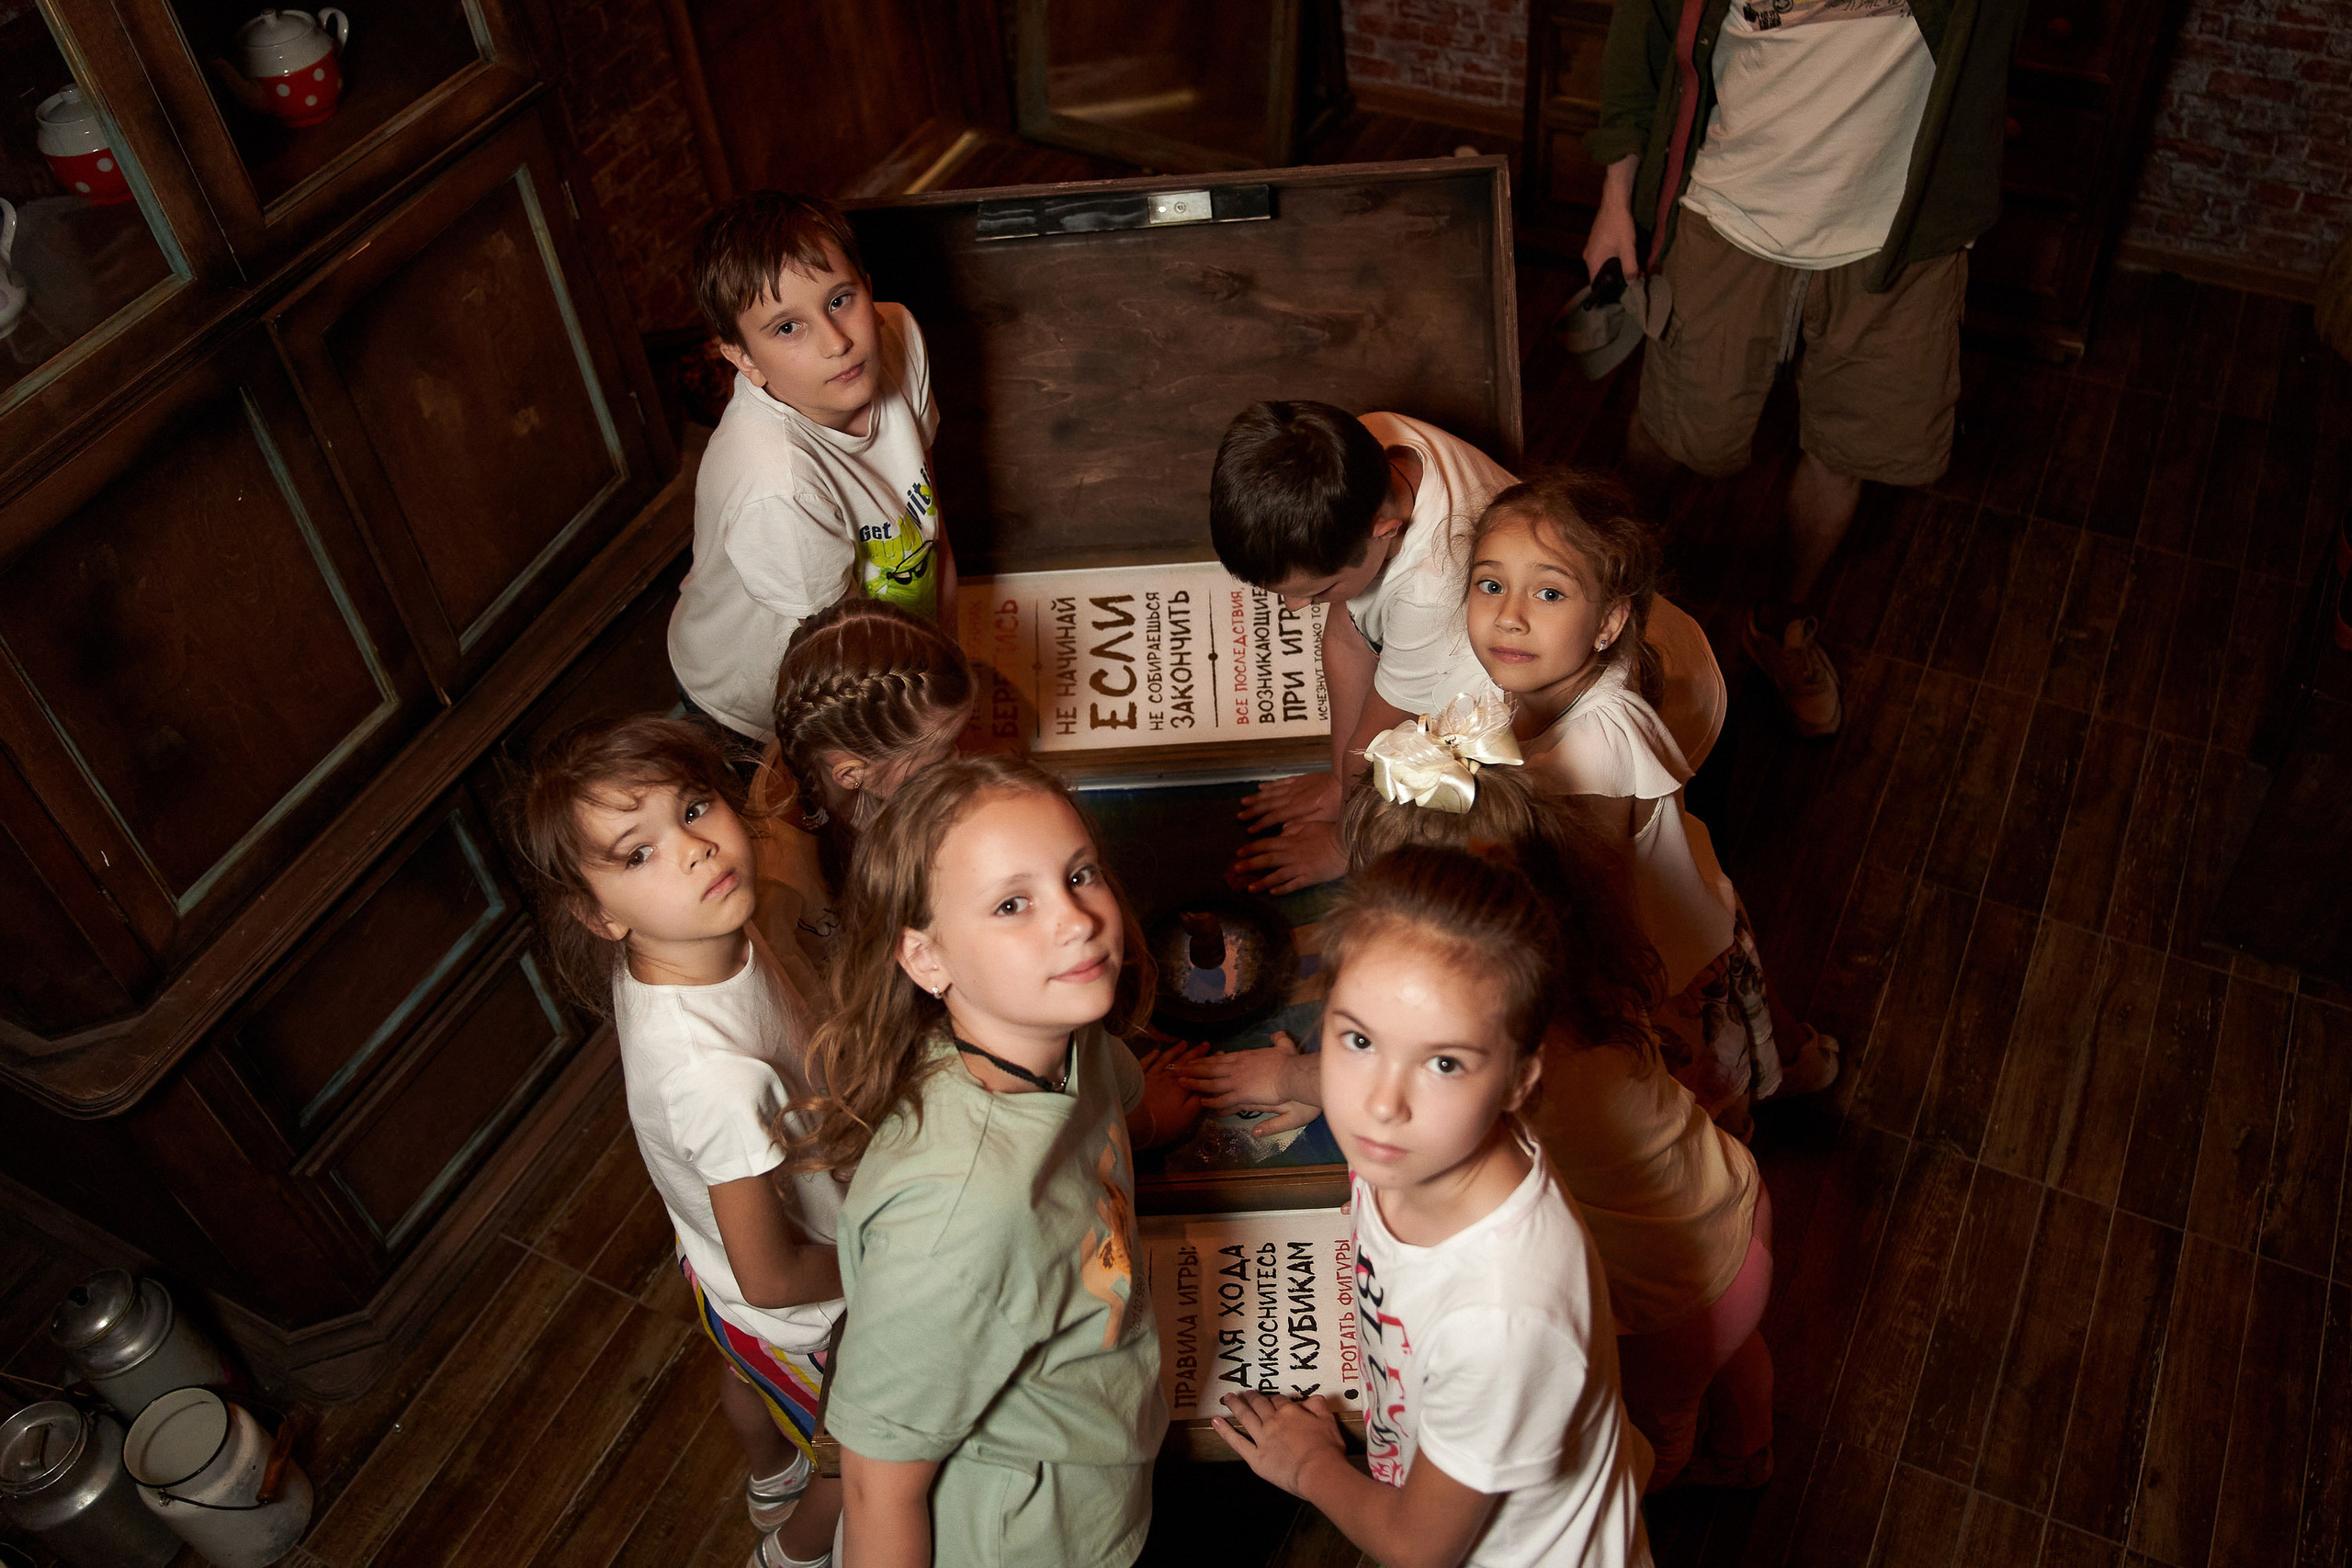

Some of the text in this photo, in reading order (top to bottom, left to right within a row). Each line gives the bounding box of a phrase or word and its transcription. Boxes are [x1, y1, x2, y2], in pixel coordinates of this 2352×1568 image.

[859, 522, 892, 542] Get
[1050, 597, 1078, 736] НЕ НАЧИНАЙ
[1089, 594, 1137, 730] ЕСЛИ
[1146, 592, 1164, 731] НЕ СОБИРАЕШЬСЯ
[1168, 590, 1195, 728] ЗАКОНЧИТЬ
[1230, 587, 1250, 726] ВСЕ ПОСЛЕДСТВИЯ,
[1251, 588, 1275, 724] ВОЗНИКАЮЩИЕ
[1282, 671, 1307, 723] ПРИ
[1312, 623, 1323, 662] ТОЛЬКО
[1174, 1246, 1198, 1409] ПРАВИЛА ИГРЫ:
[1218, 1245, 1252, 1388] ДЛЯ ХОДА
[1286, 1242, 1320, 1371] КУБИКАМ
[1338, 1311, 1359, 1383] ТРОГАТЬ
